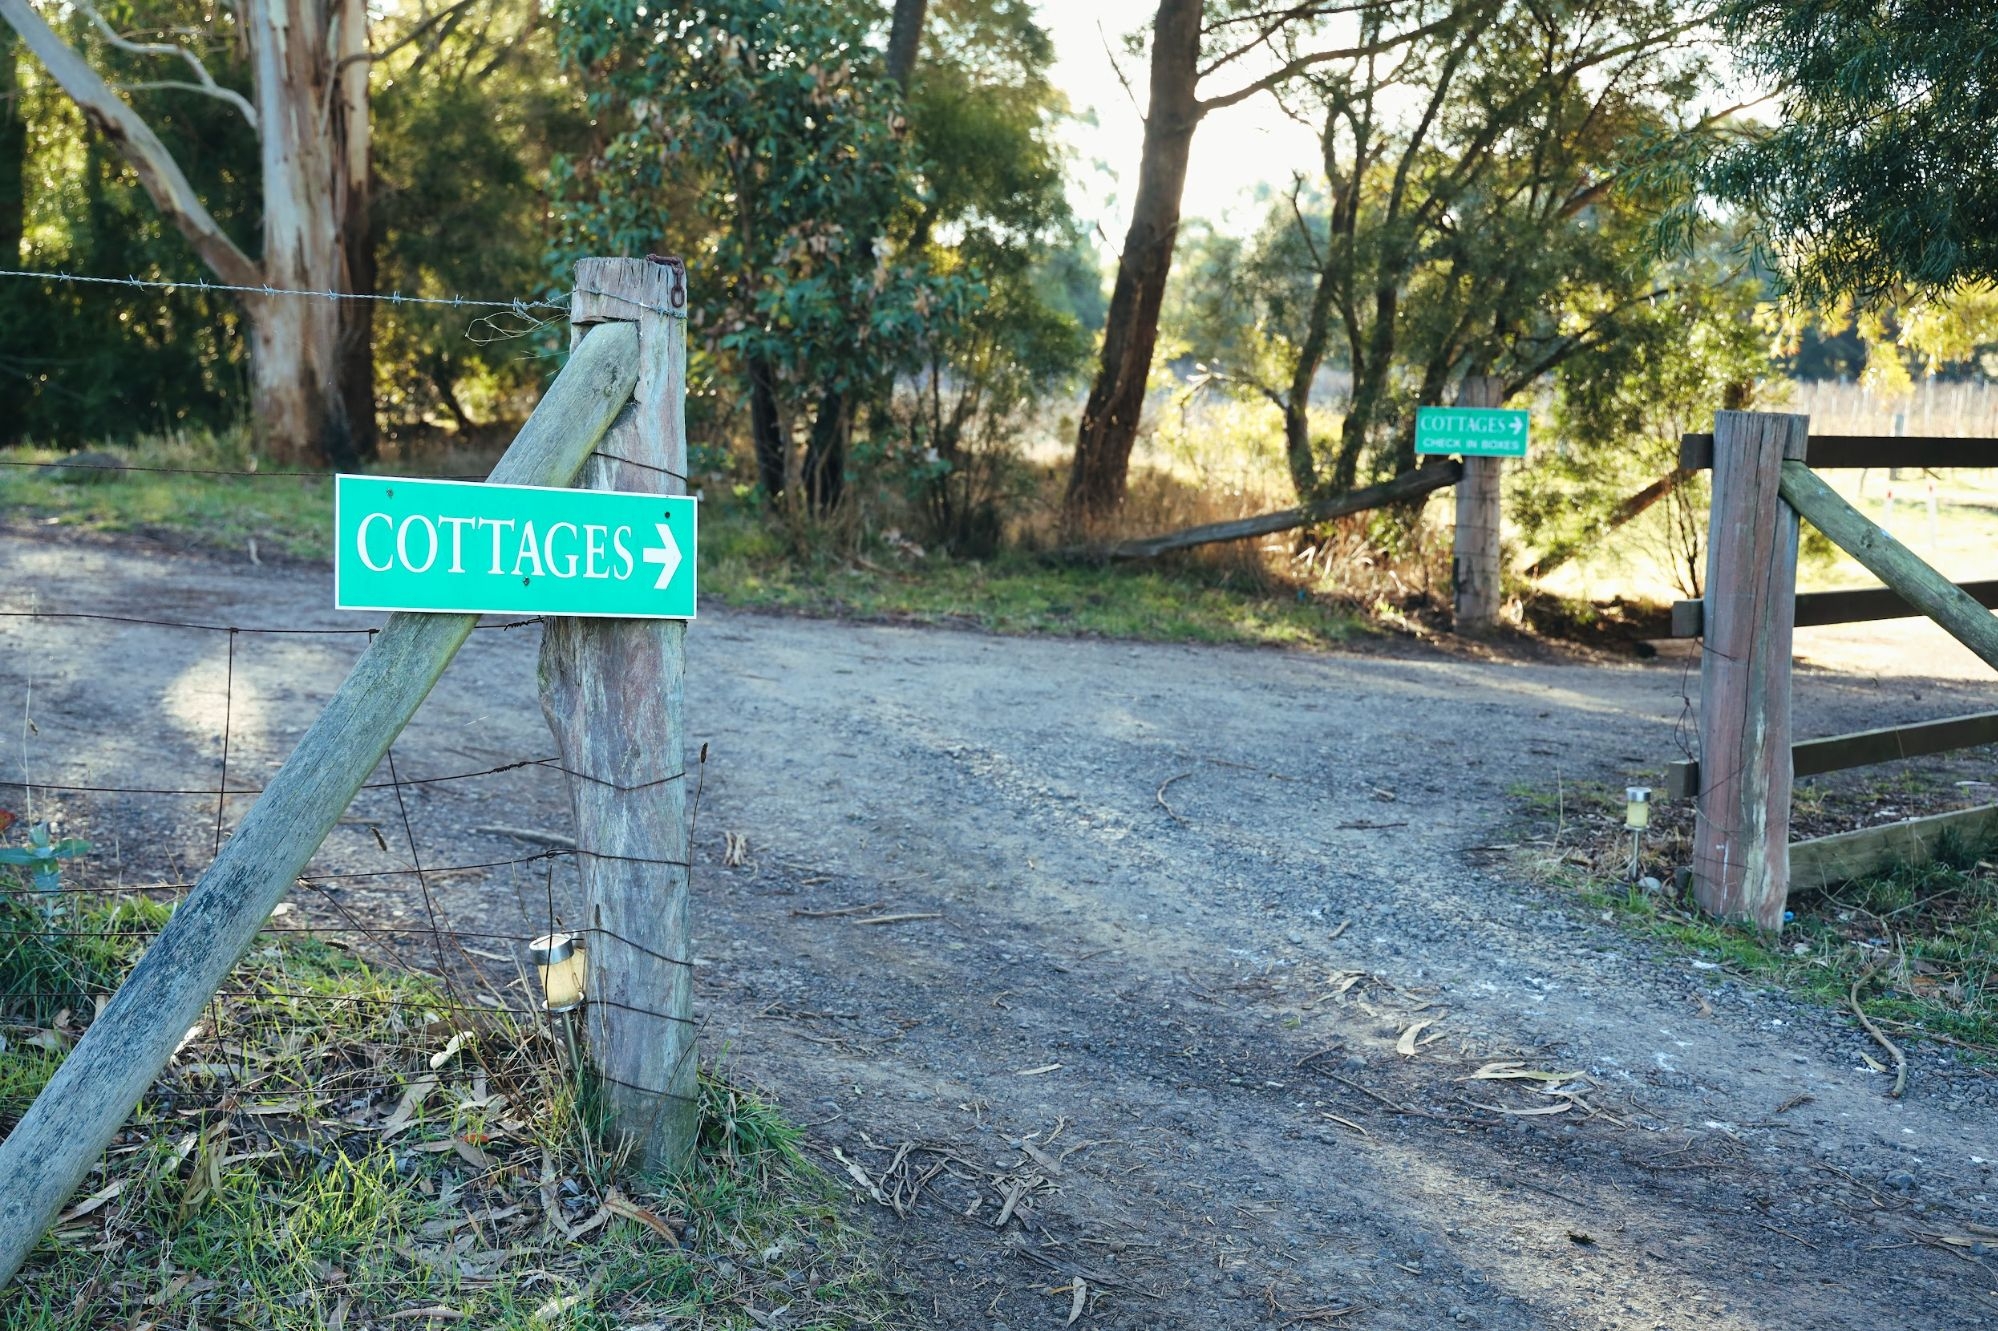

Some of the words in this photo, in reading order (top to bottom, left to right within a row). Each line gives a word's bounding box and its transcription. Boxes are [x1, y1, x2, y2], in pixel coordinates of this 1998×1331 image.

[1420, 416, 1506, 433] COTTAGES
[1423, 438, 1461, 448] CHECK
[1466, 440, 1477, 449] IN
[1481, 440, 1519, 450] BOXES
[357, 512, 634, 581] COTTAGES
